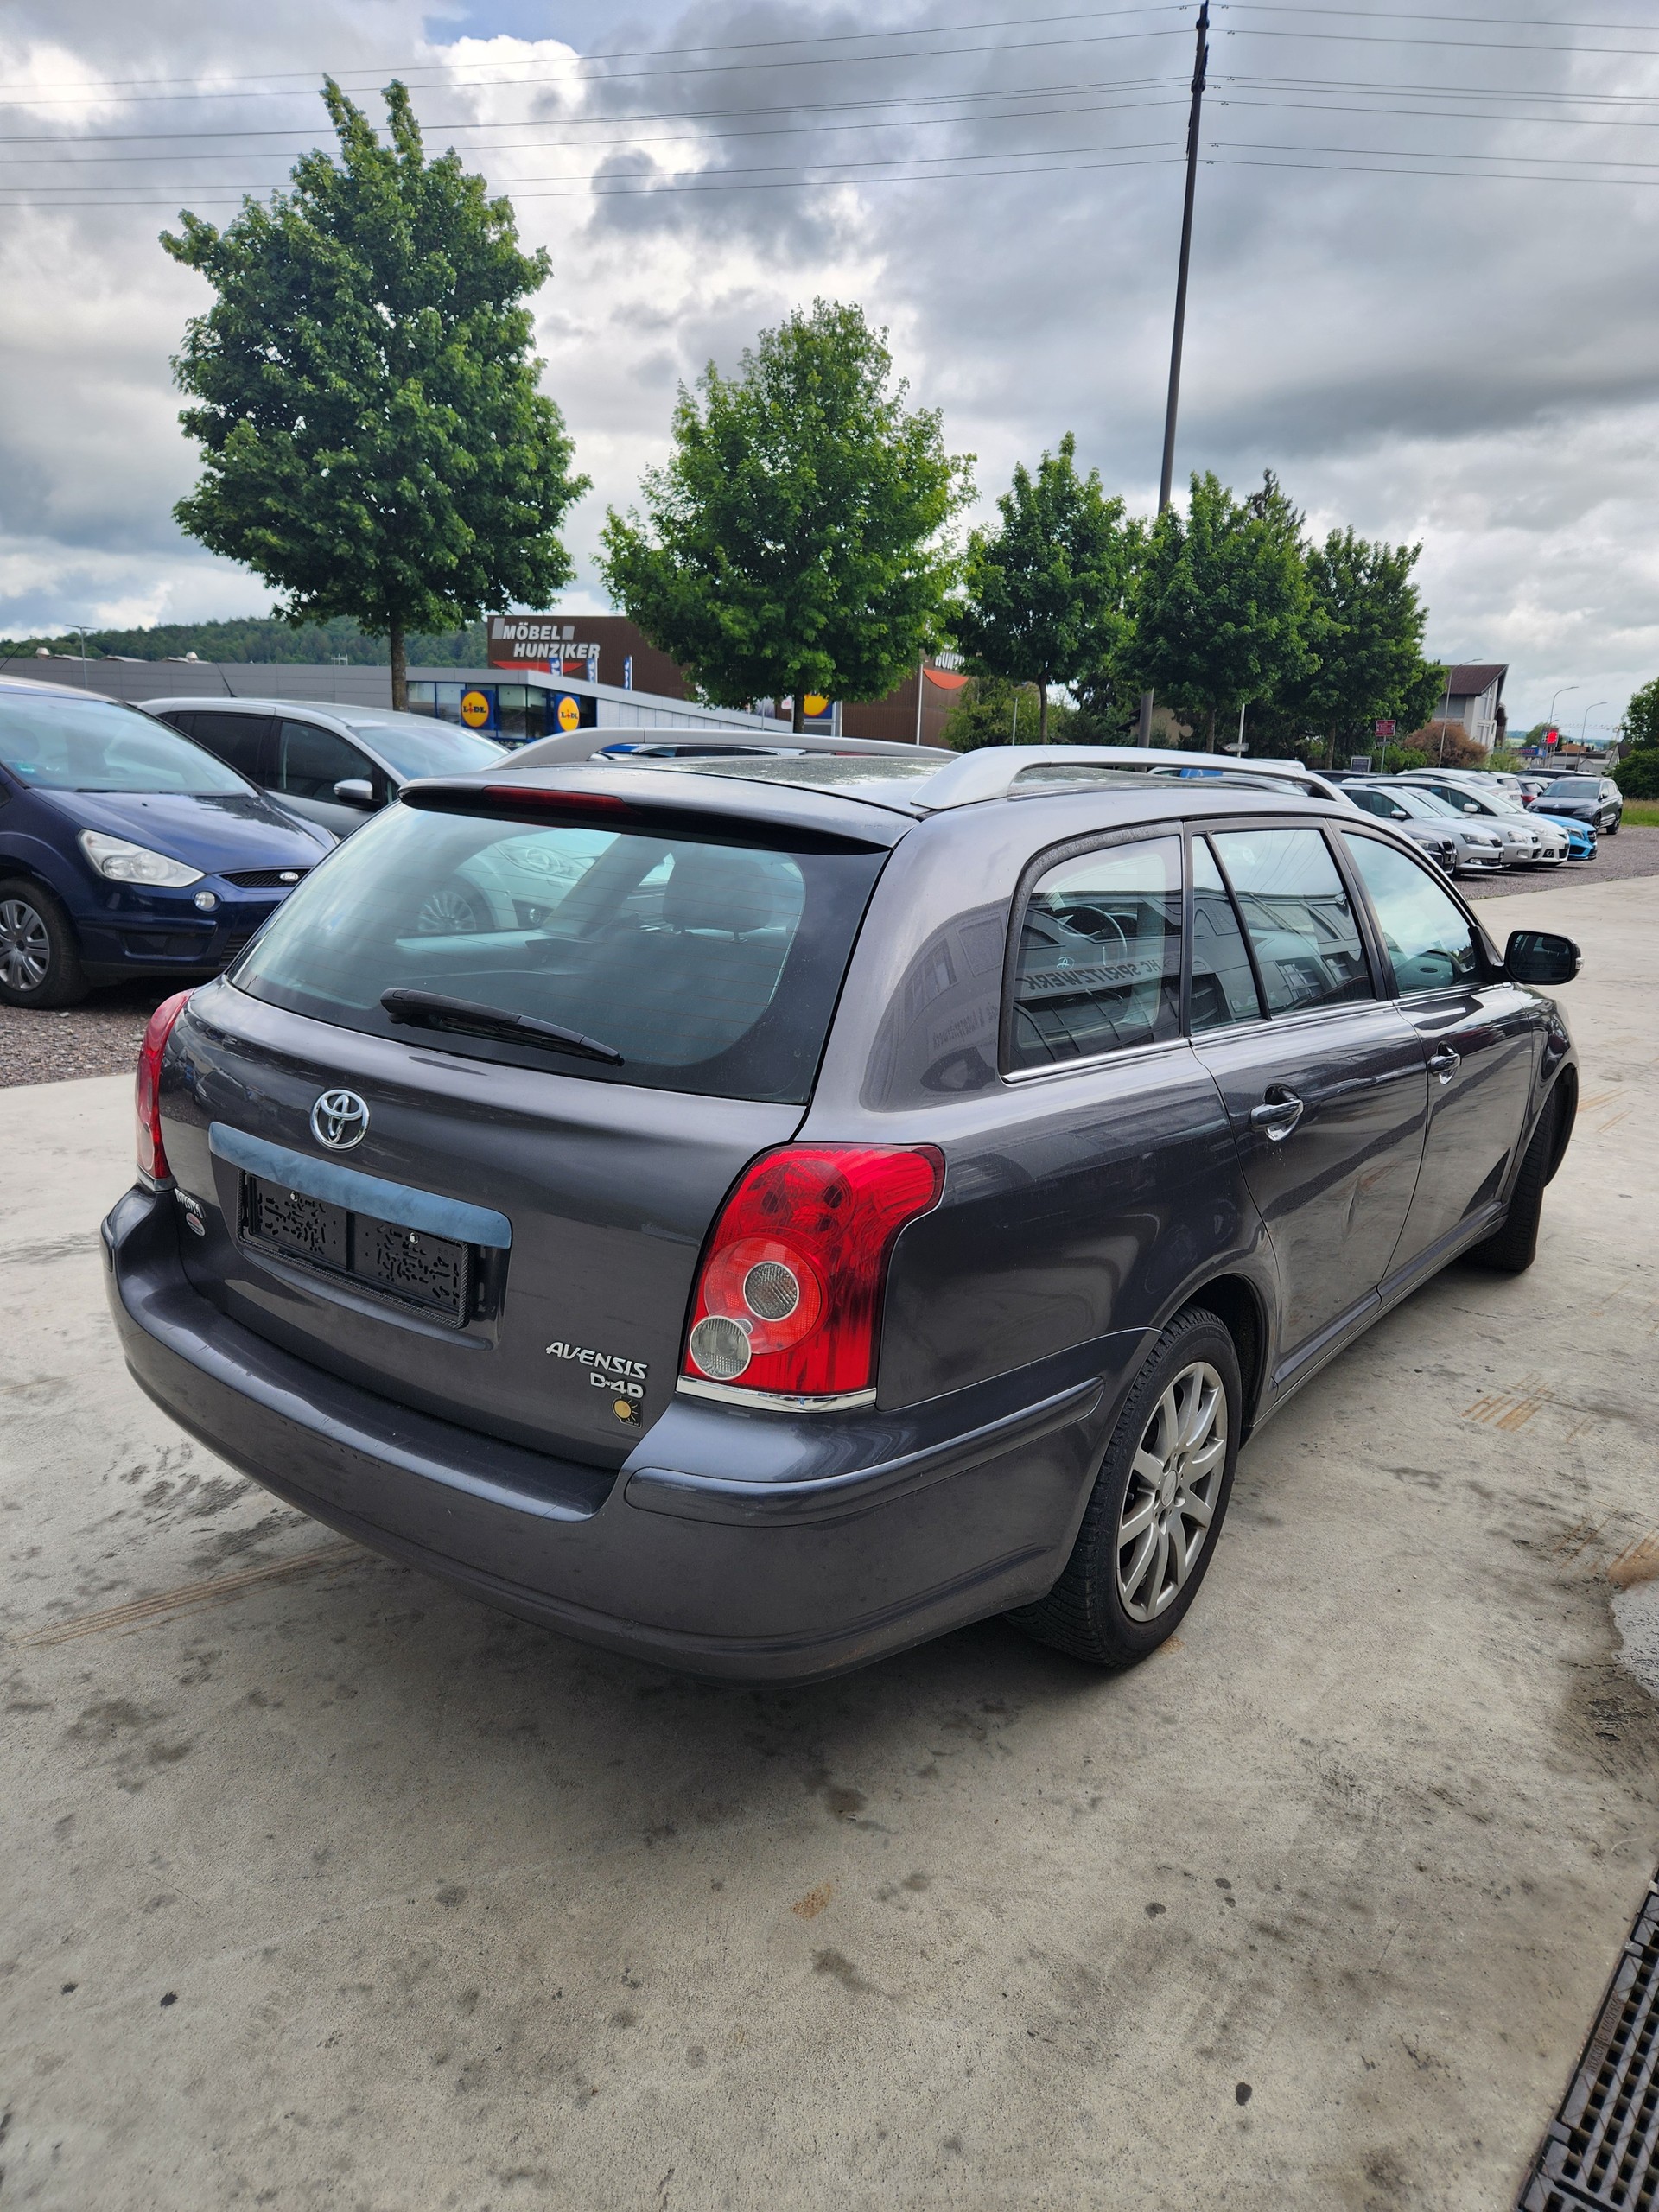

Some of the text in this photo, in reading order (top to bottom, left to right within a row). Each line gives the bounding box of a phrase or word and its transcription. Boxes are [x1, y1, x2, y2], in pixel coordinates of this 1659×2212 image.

[503, 622, 561, 641] MÖBEL
[513, 643, 601, 659] HUNZIKER
[545, 1341, 648, 1380] AVENSIS
[590, 1372, 644, 1399] D-4D
